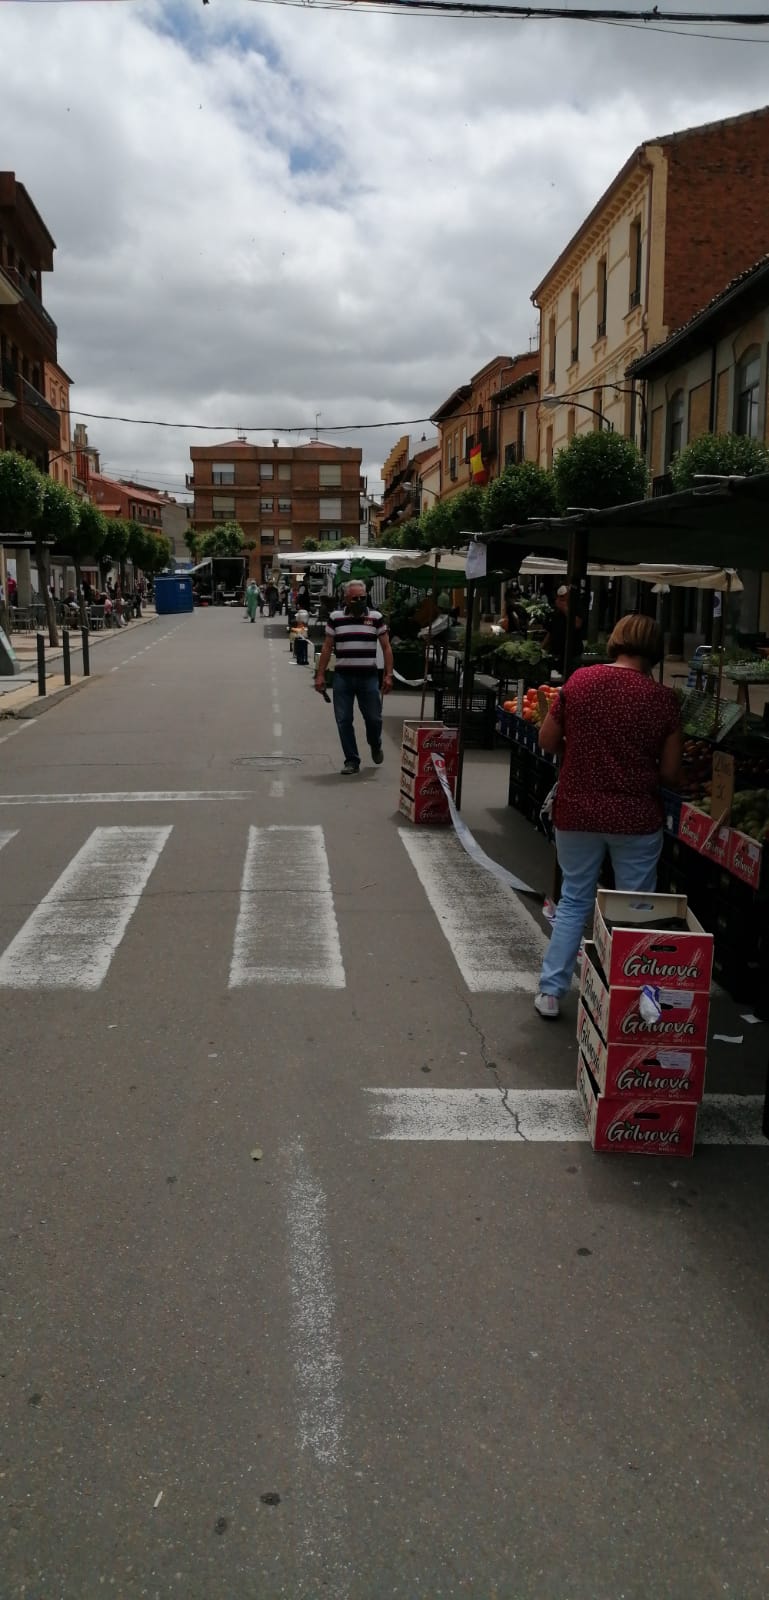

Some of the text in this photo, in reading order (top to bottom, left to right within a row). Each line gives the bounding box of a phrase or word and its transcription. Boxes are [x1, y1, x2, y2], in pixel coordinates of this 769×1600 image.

[624, 955, 699, 978] Golnova
[618, 1070, 689, 1090] Golnova
[608, 1122, 680, 1143] Golnova
